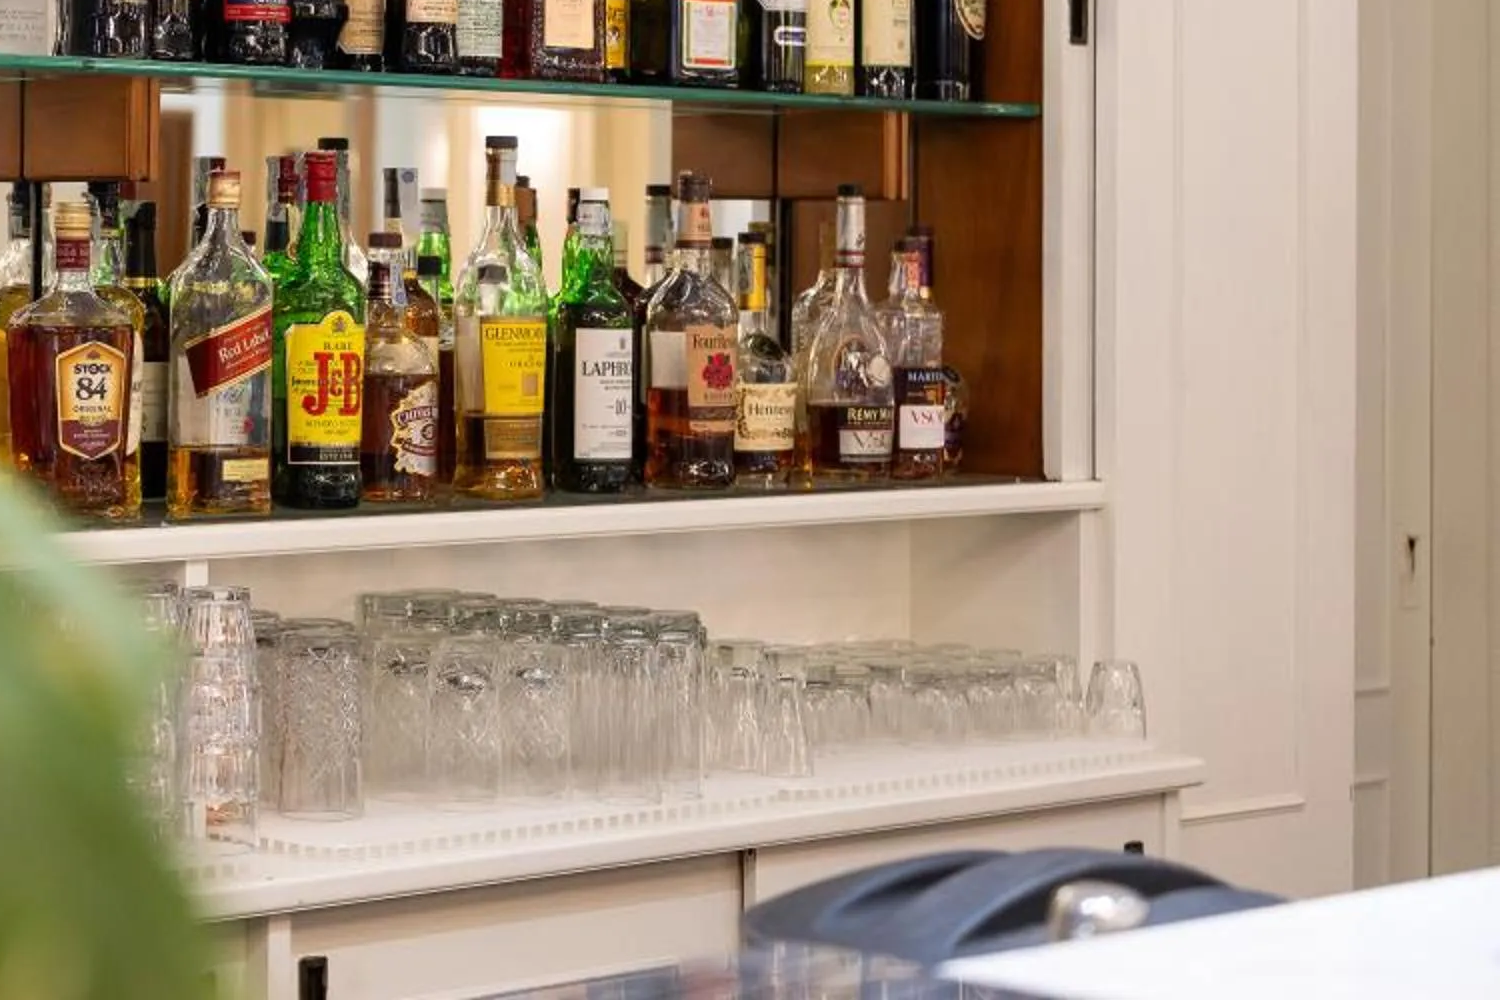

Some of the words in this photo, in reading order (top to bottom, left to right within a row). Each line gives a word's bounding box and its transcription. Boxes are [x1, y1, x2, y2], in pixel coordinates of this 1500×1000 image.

[217, 342, 241, 364] Red
[73, 363, 112, 375] STOCK
[74, 378, 107, 401] 84
[301, 351, 361, 417] J&B
